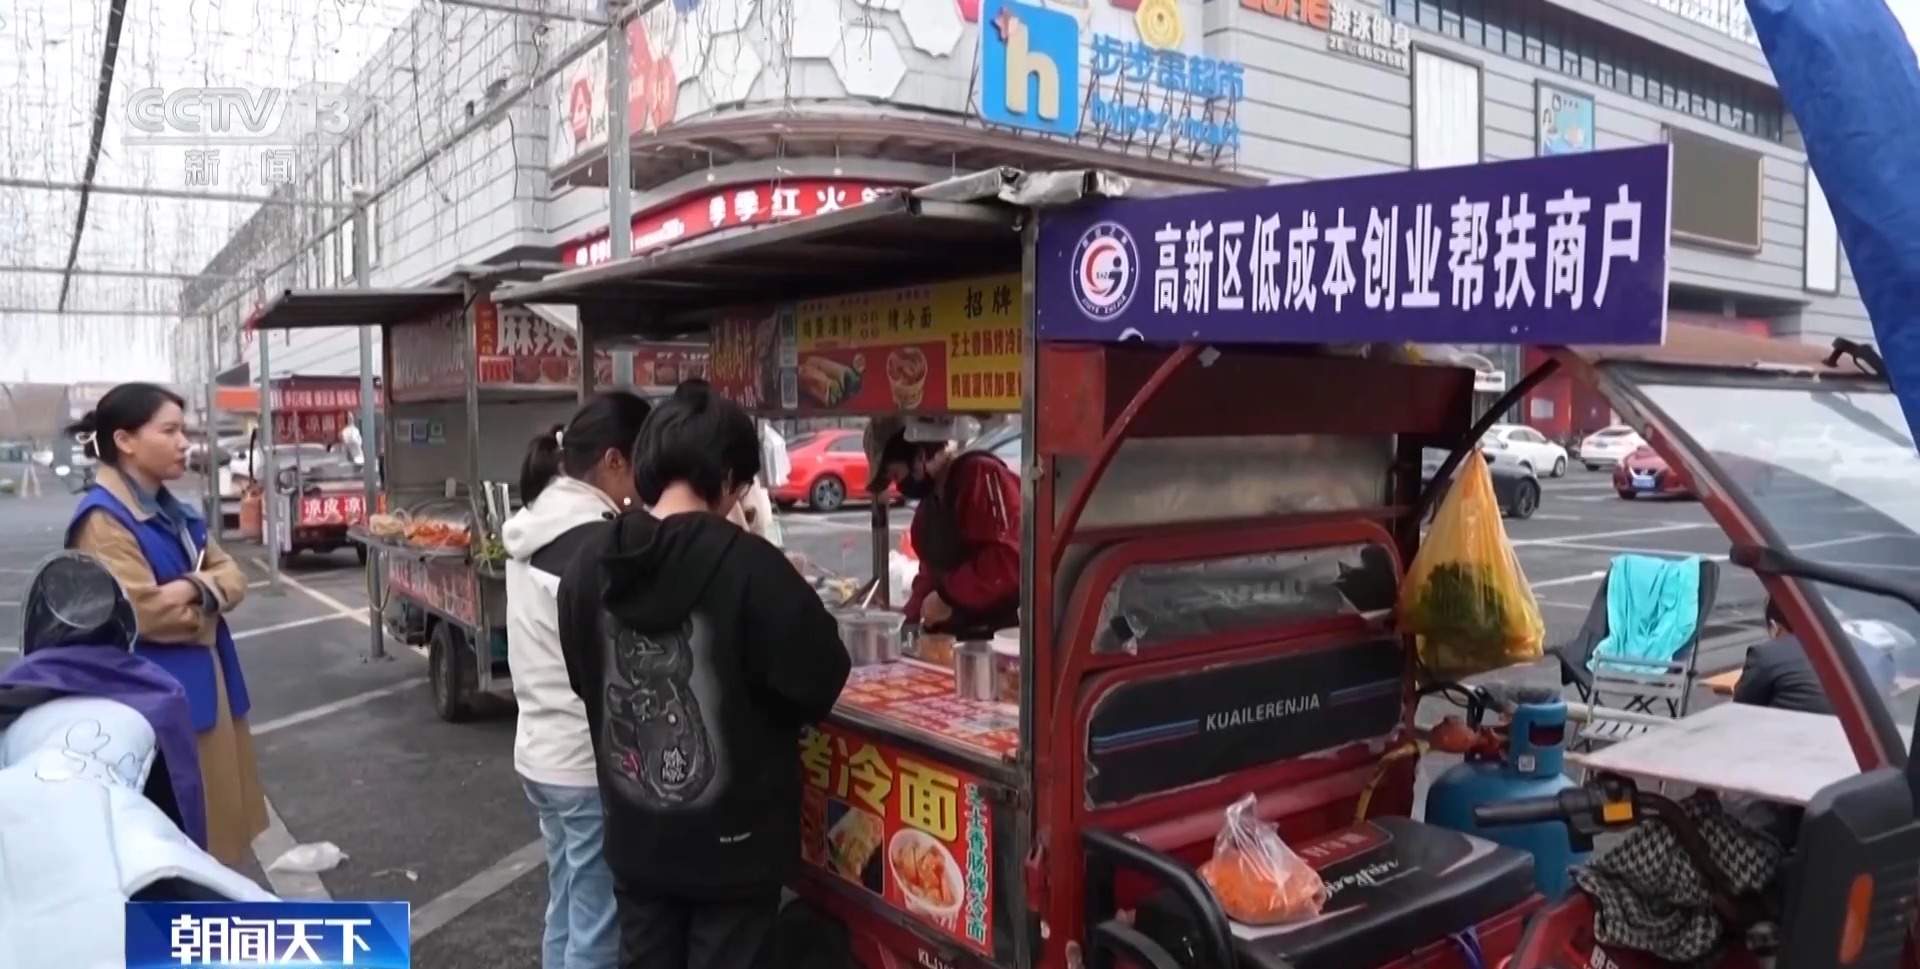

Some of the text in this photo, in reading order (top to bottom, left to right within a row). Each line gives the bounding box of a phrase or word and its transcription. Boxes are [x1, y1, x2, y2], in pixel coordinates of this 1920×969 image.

[1330, 1, 1411, 53] 游泳健身
[709, 185, 892, 228] 季季红火
[1153, 183, 1643, 314] 高新区低成本创业帮扶商户
[964, 284, 1012, 320] 招牌
[1205, 693, 1321, 732] KUAILERENJIA
